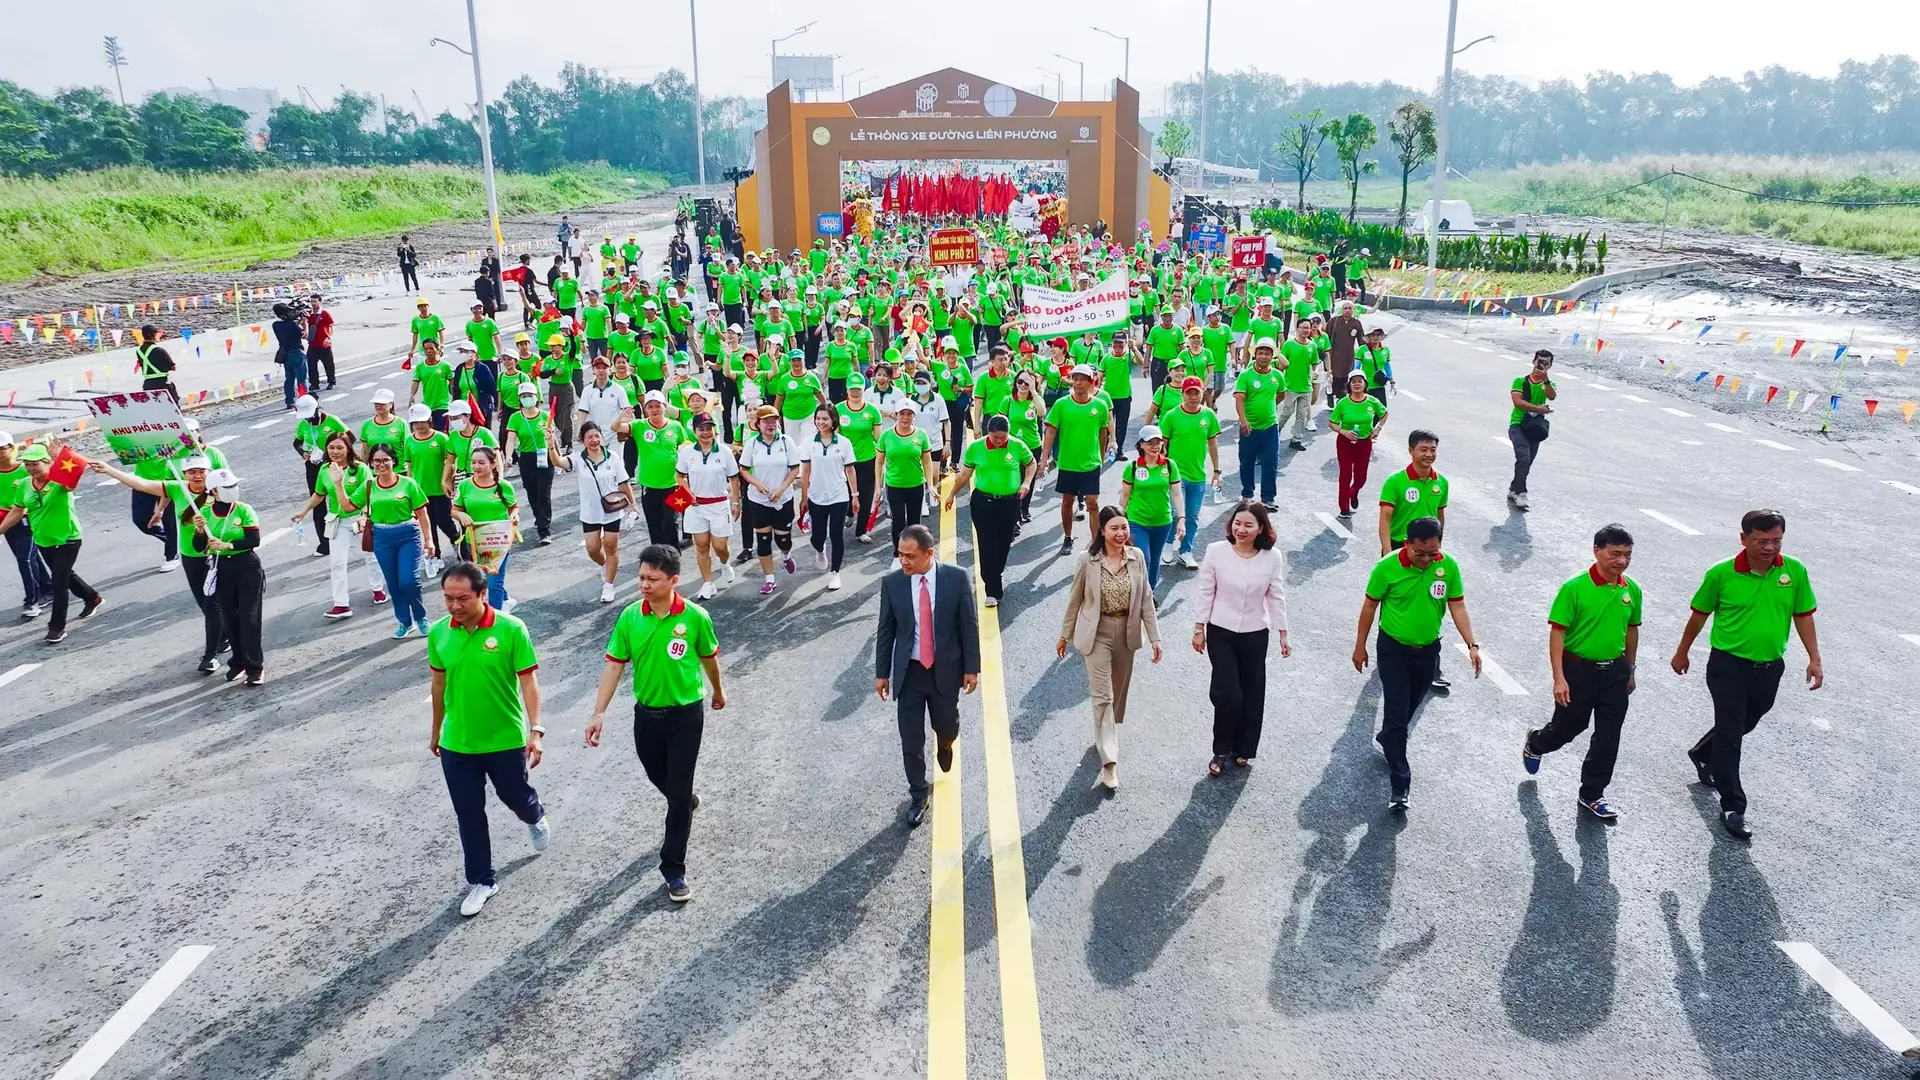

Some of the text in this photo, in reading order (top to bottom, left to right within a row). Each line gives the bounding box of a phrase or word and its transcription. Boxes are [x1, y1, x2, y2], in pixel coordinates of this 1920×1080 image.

[850, 128, 1058, 140] LỄ THÔNG XE ĐƯỜNG LIÊN PHƯỜNG
[1241, 240, 1263, 252] KHU PHỐ
[934, 245, 974, 260] KHU PHỐ 21
[1242, 254, 1256, 264] 44
[1085, 312, 1096, 320] 50
[1106, 310, 1115, 318] 51
[111, 426, 132, 436] KHU
[151, 423, 164, 431] 48
[1408, 490, 1418, 500] 121
[671, 642, 685, 656] 99
